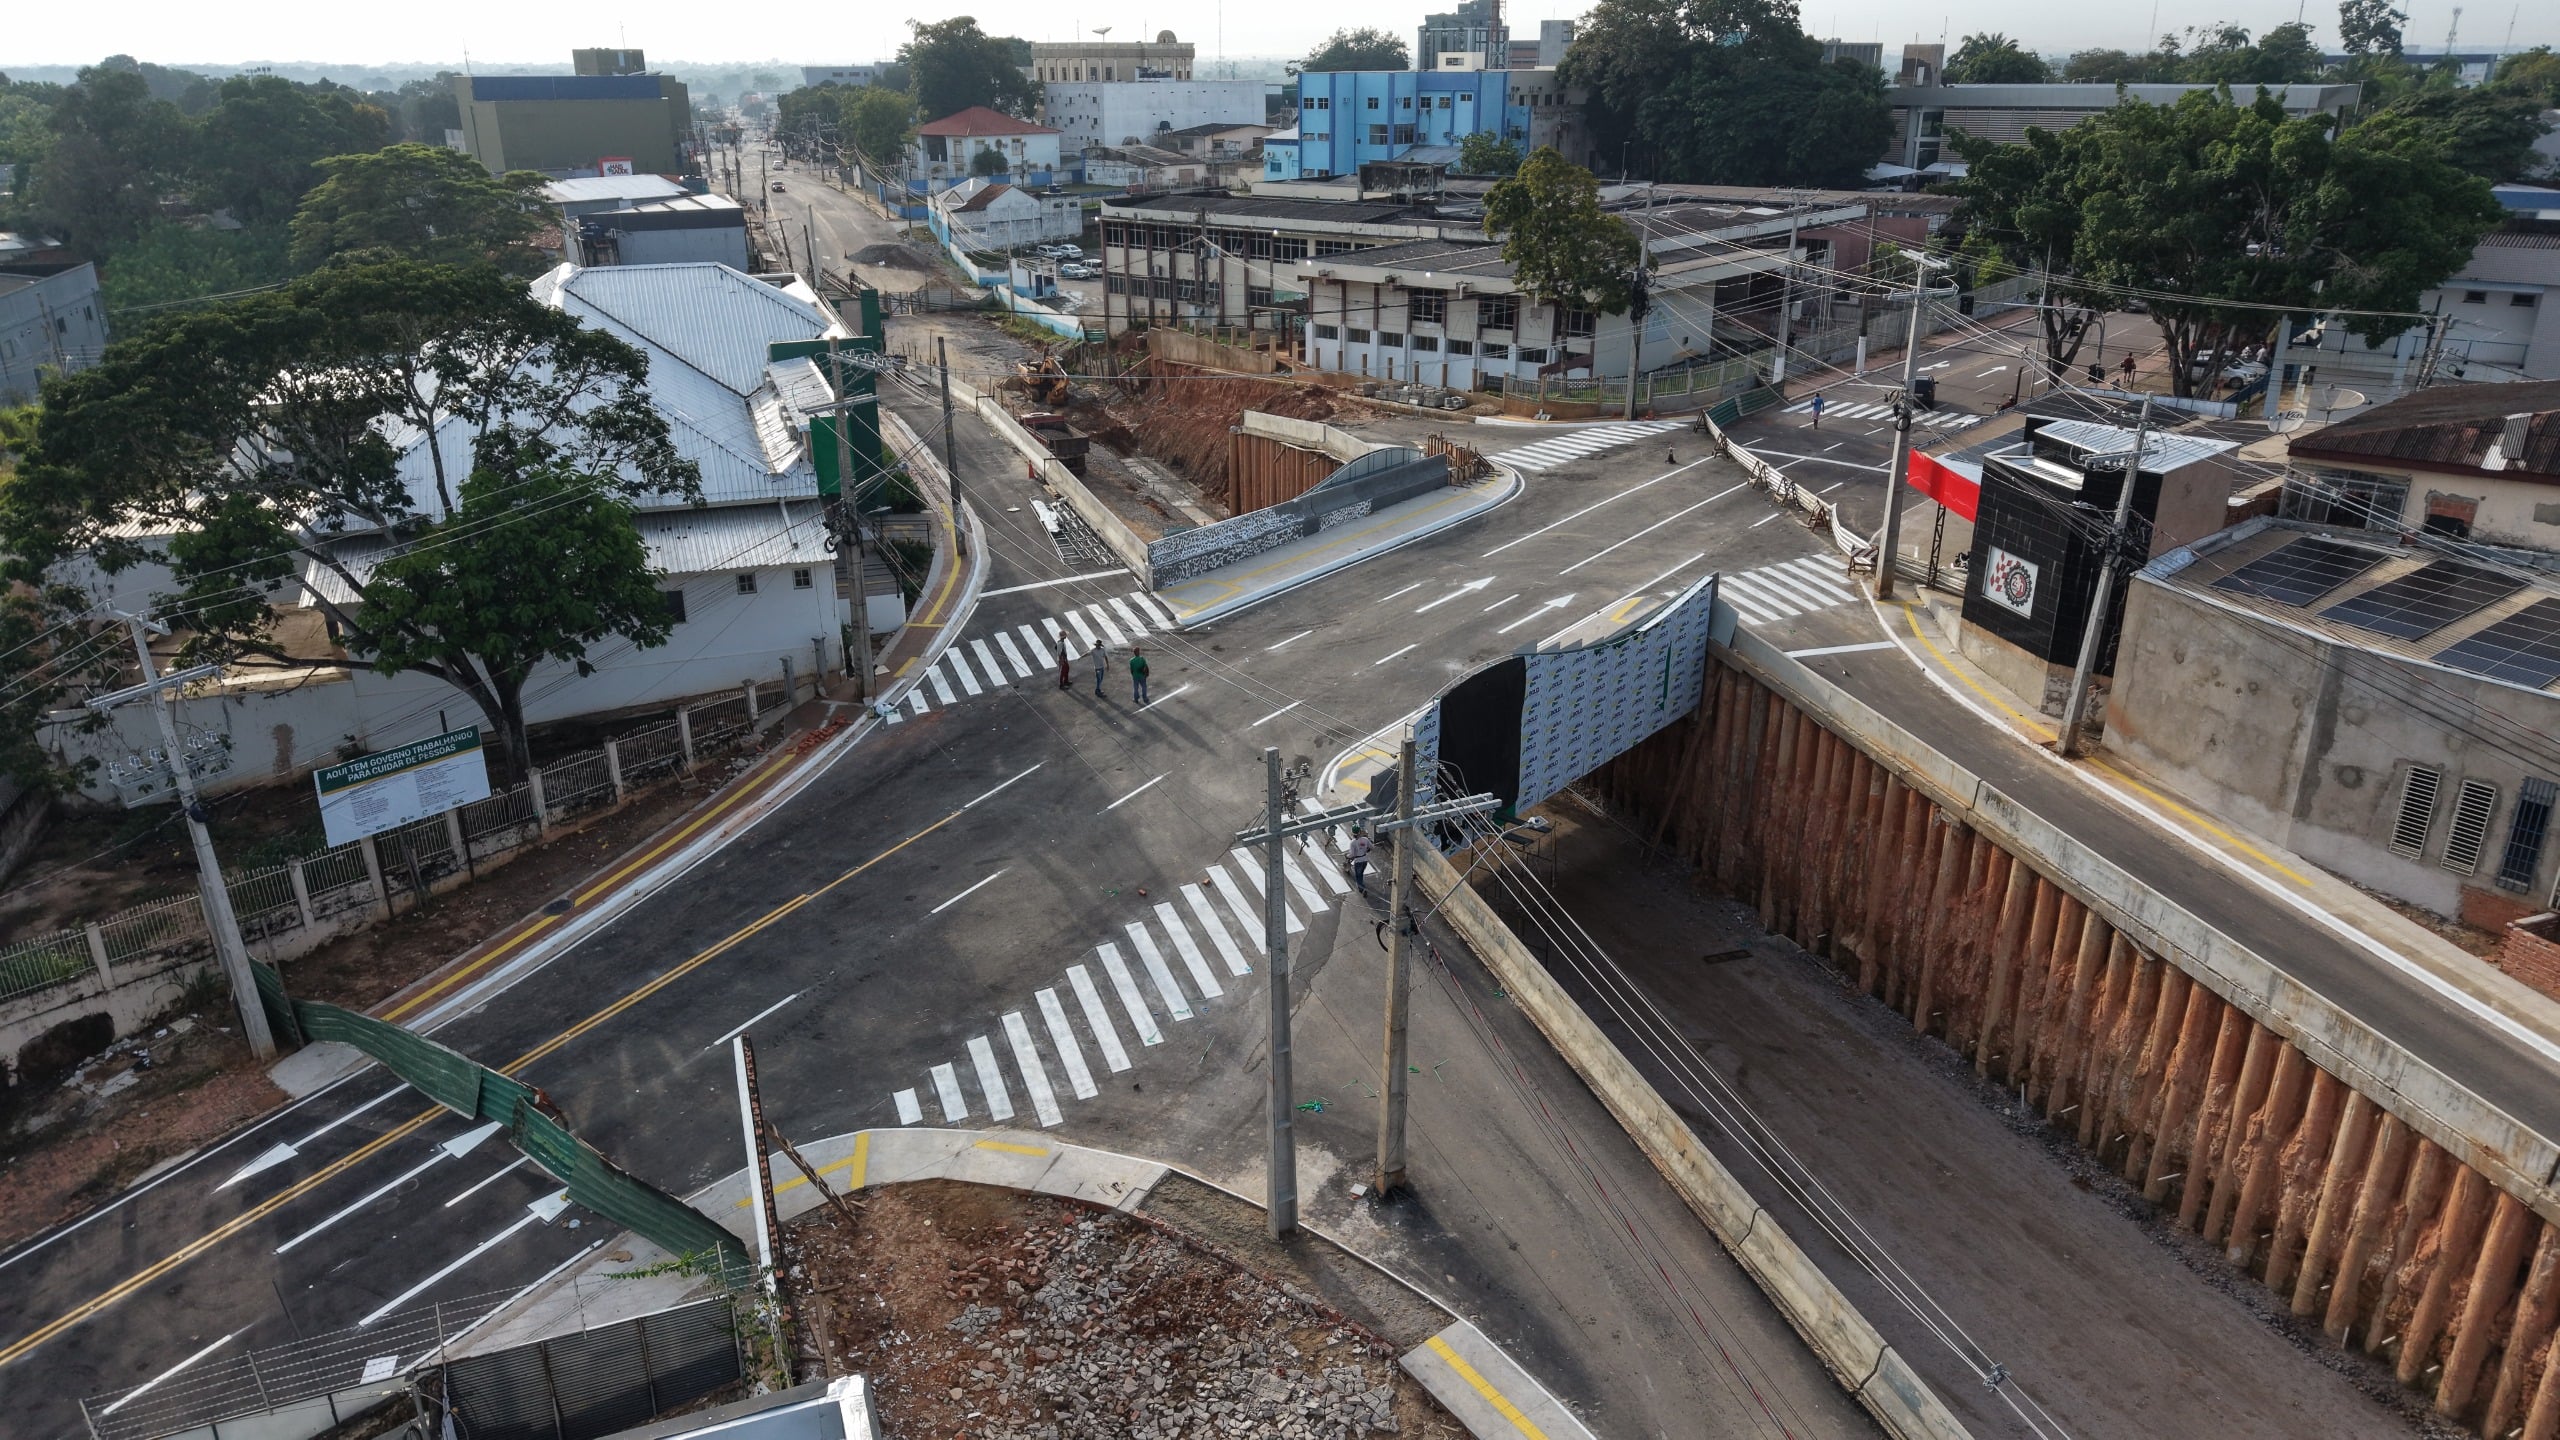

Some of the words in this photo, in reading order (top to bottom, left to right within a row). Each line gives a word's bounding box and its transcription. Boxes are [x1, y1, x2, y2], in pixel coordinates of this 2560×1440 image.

[326, 768, 348, 780] AQUI
[349, 762, 368, 773] TEM
[370, 748, 411, 766] GOVERNO
[412, 731, 473, 753] TRABALHANDO
[348, 770, 371, 782] PARA
[372, 760, 405, 774] CUIDAR
[406, 755, 417, 764] DE
[418, 744, 456, 761] PESSOAS
